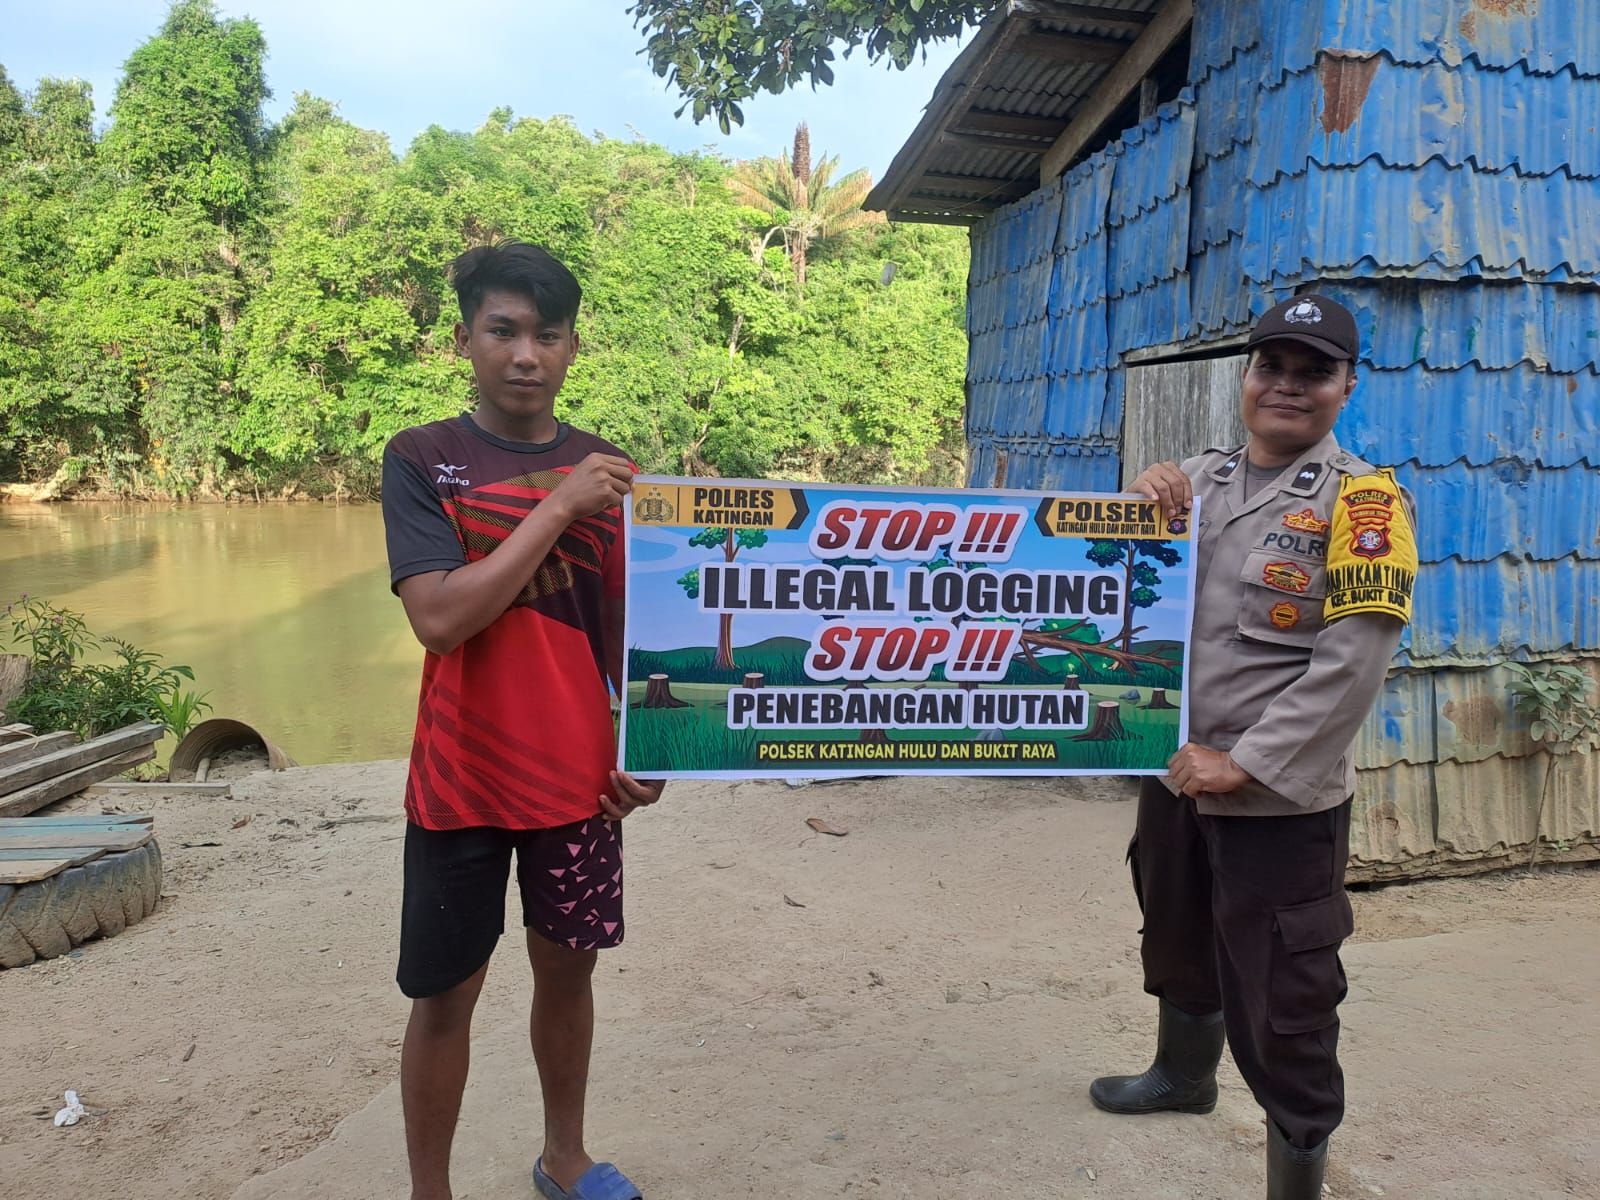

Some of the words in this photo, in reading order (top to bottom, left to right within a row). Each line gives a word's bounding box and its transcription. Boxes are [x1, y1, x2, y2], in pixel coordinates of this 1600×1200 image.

[694, 488, 774, 509] POLRES
[694, 509, 774, 526] KATINGAN
[1058, 501, 1156, 523] POLSEK
[1056, 521, 1088, 533] KATINGAN
[1089, 522, 1105, 534] HULU
[1106, 523, 1120, 535] DAN
[1121, 523, 1140, 535] BUKIT
[1141, 524, 1156, 536] RAYA
[703, 567, 896, 611] ILLEGAL
[908, 571, 1120, 615] LOGGING
[732, 692, 964, 725] PENEBANGAN
[972, 693, 1084, 725] HUTAN
[759, 743, 815, 760] POLSEK
[819, 743, 895, 760] KATINGAN
[899, 743, 936, 760] HULU
[940, 743, 970, 760] DAN
[974, 743, 1018, 760] BUKIT
[1022, 743, 1056, 760] RAYA
